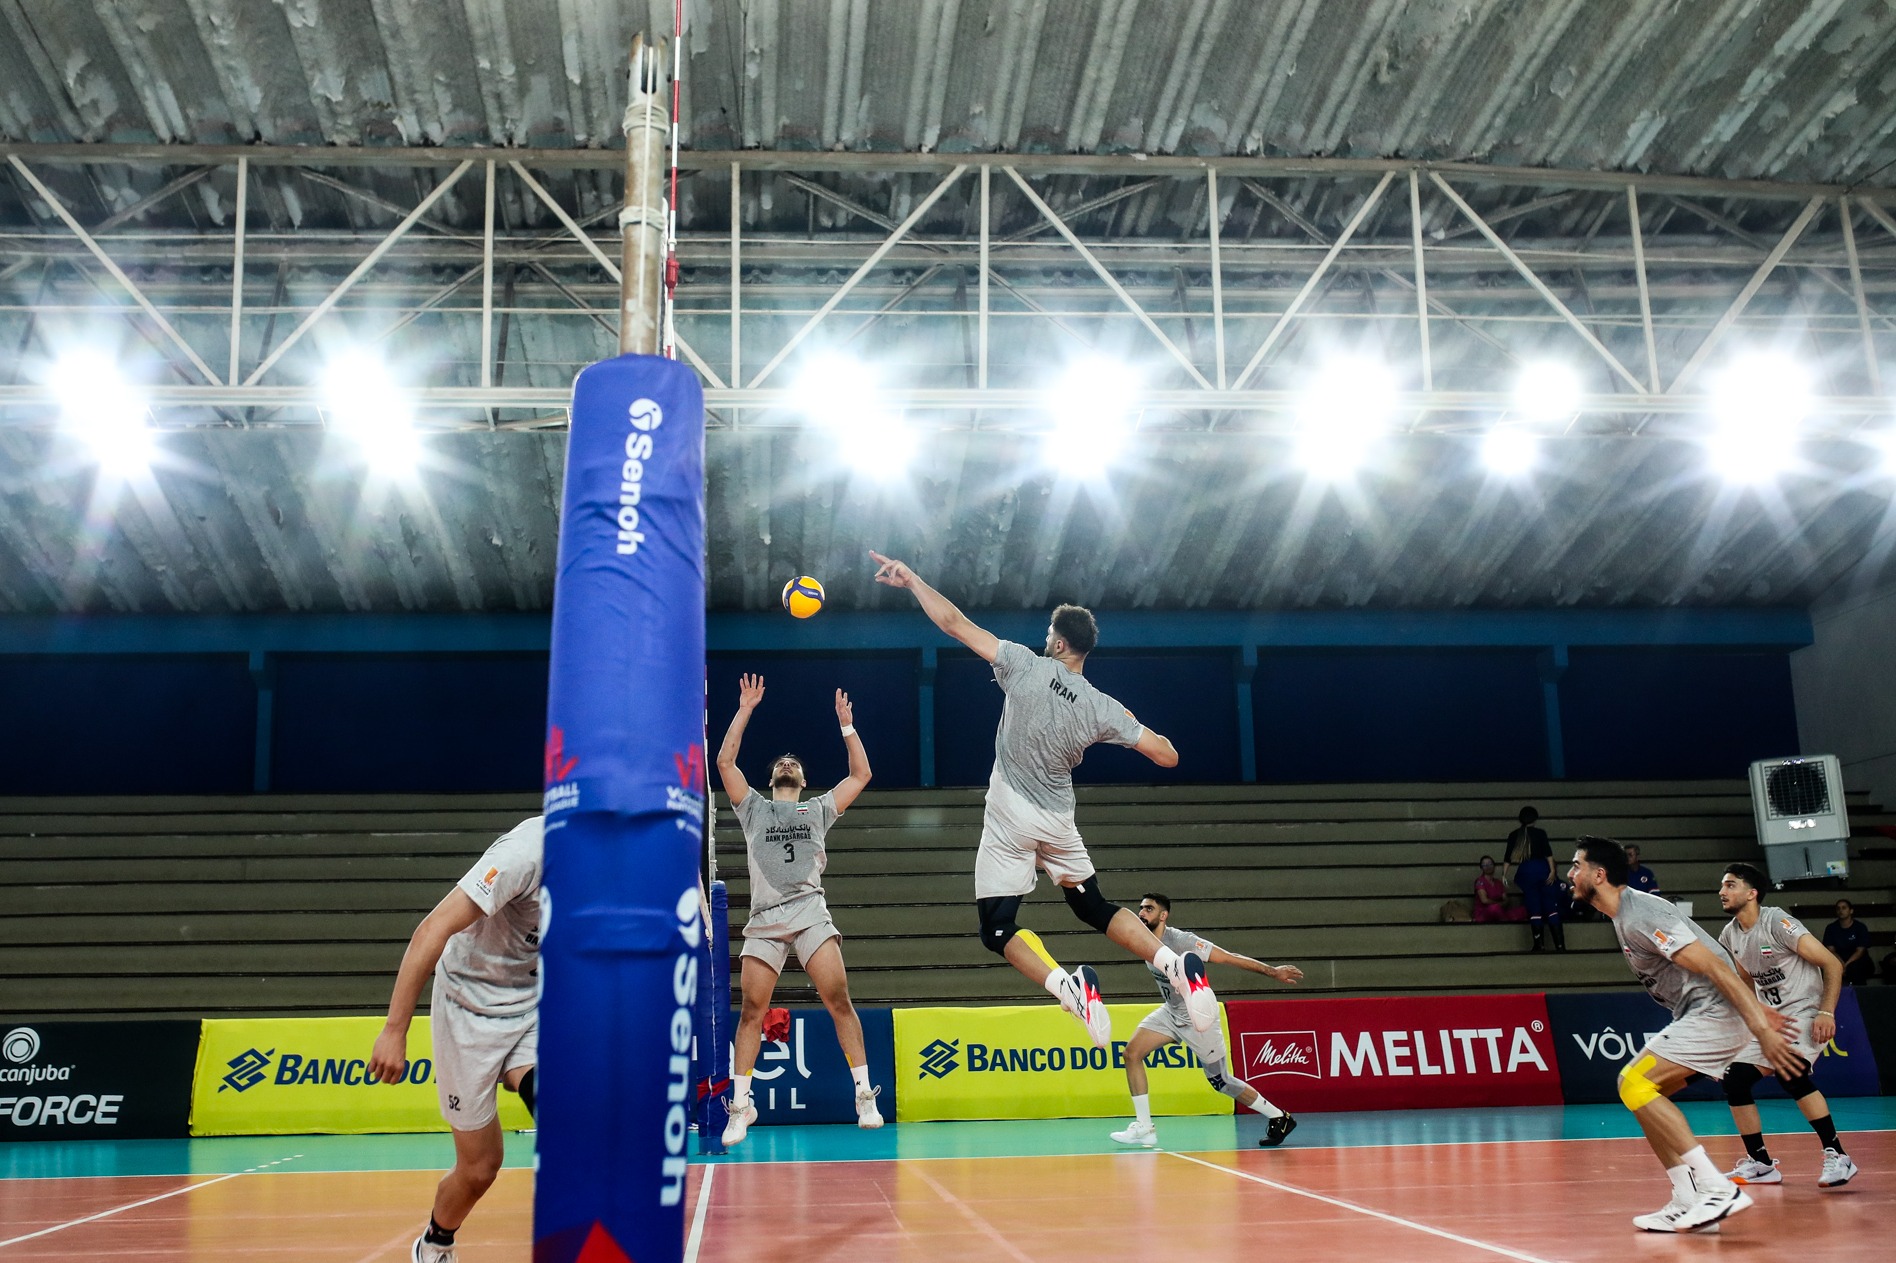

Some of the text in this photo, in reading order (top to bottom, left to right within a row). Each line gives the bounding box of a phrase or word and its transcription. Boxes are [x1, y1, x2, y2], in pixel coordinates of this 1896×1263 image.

[616, 432, 654, 555] Senoh
[1049, 678, 1078, 704] IRAN
[784, 843, 795, 863] 3
[1761, 987, 1782, 1005] 19
[967, 1043, 1066, 1072] BANCO
[1071, 1046, 1107, 1070] DO
[1252, 1039, 1310, 1067] Melitta
[1330, 1026, 1549, 1078] MELITTA
[0, 1064, 70, 1086] canjuba
[660, 953, 698, 1207] Senoh
[448, 1094, 462, 1112] 52
[749, 1087, 806, 1110] IL
